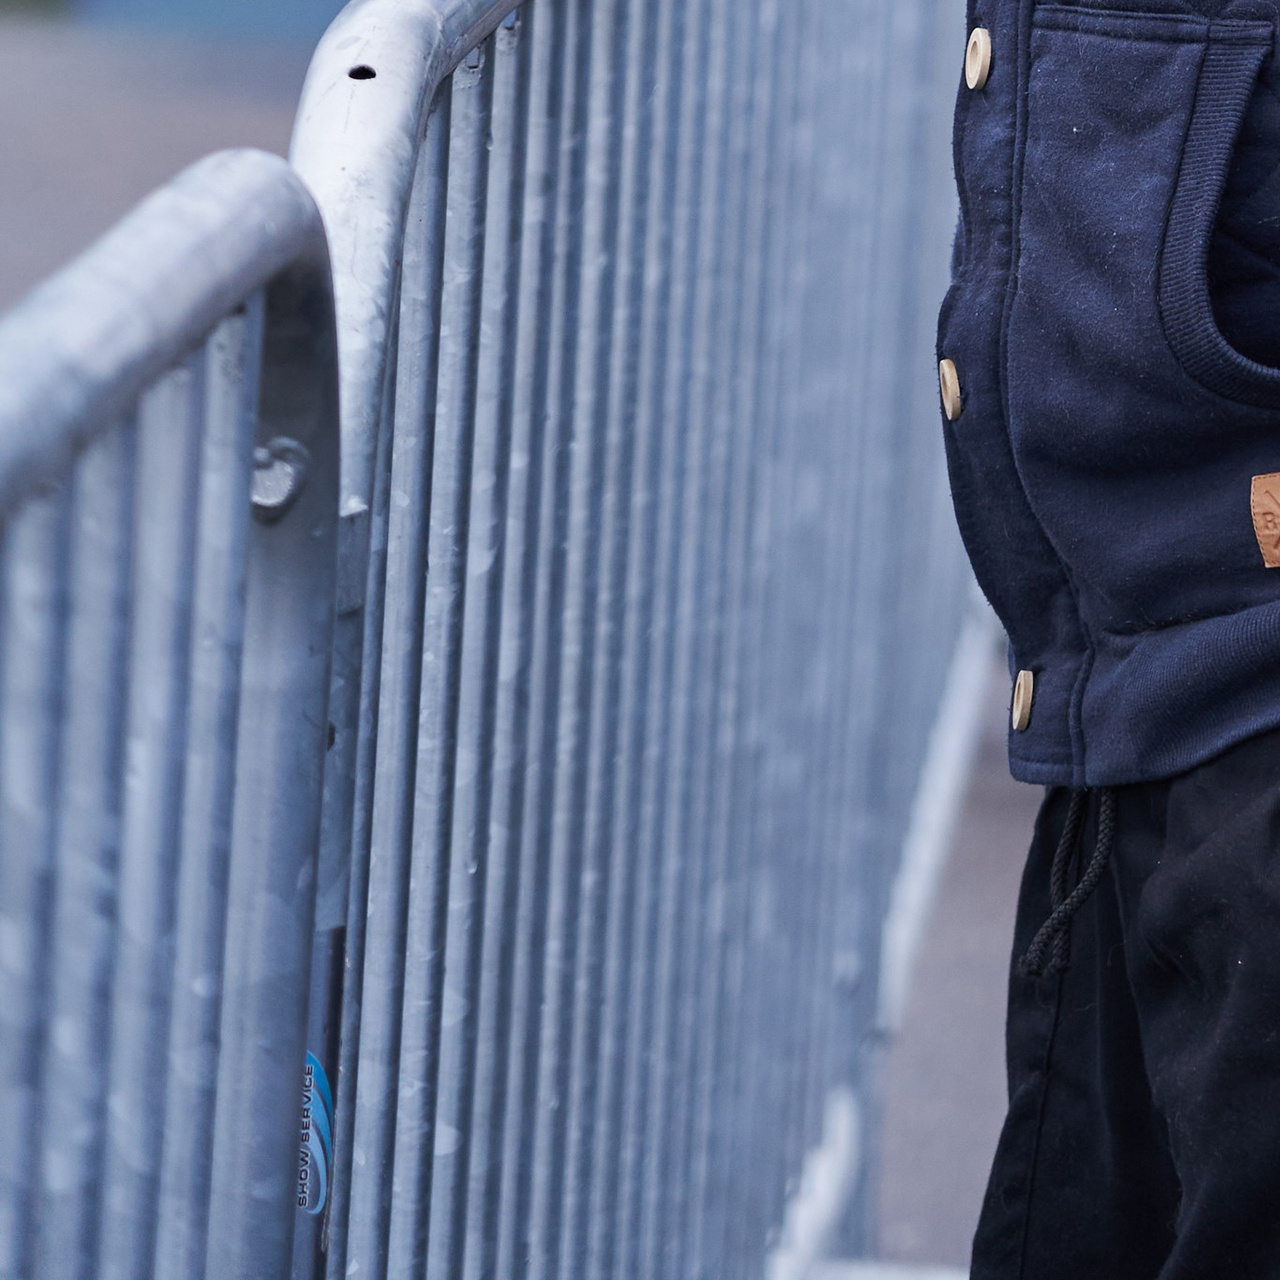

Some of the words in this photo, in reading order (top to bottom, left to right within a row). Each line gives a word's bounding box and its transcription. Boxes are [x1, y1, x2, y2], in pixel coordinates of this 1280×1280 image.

[1262, 511, 1278, 530] R
[301, 1064, 314, 1143] SERVICE
[298, 1149, 311, 1207] SHOW
